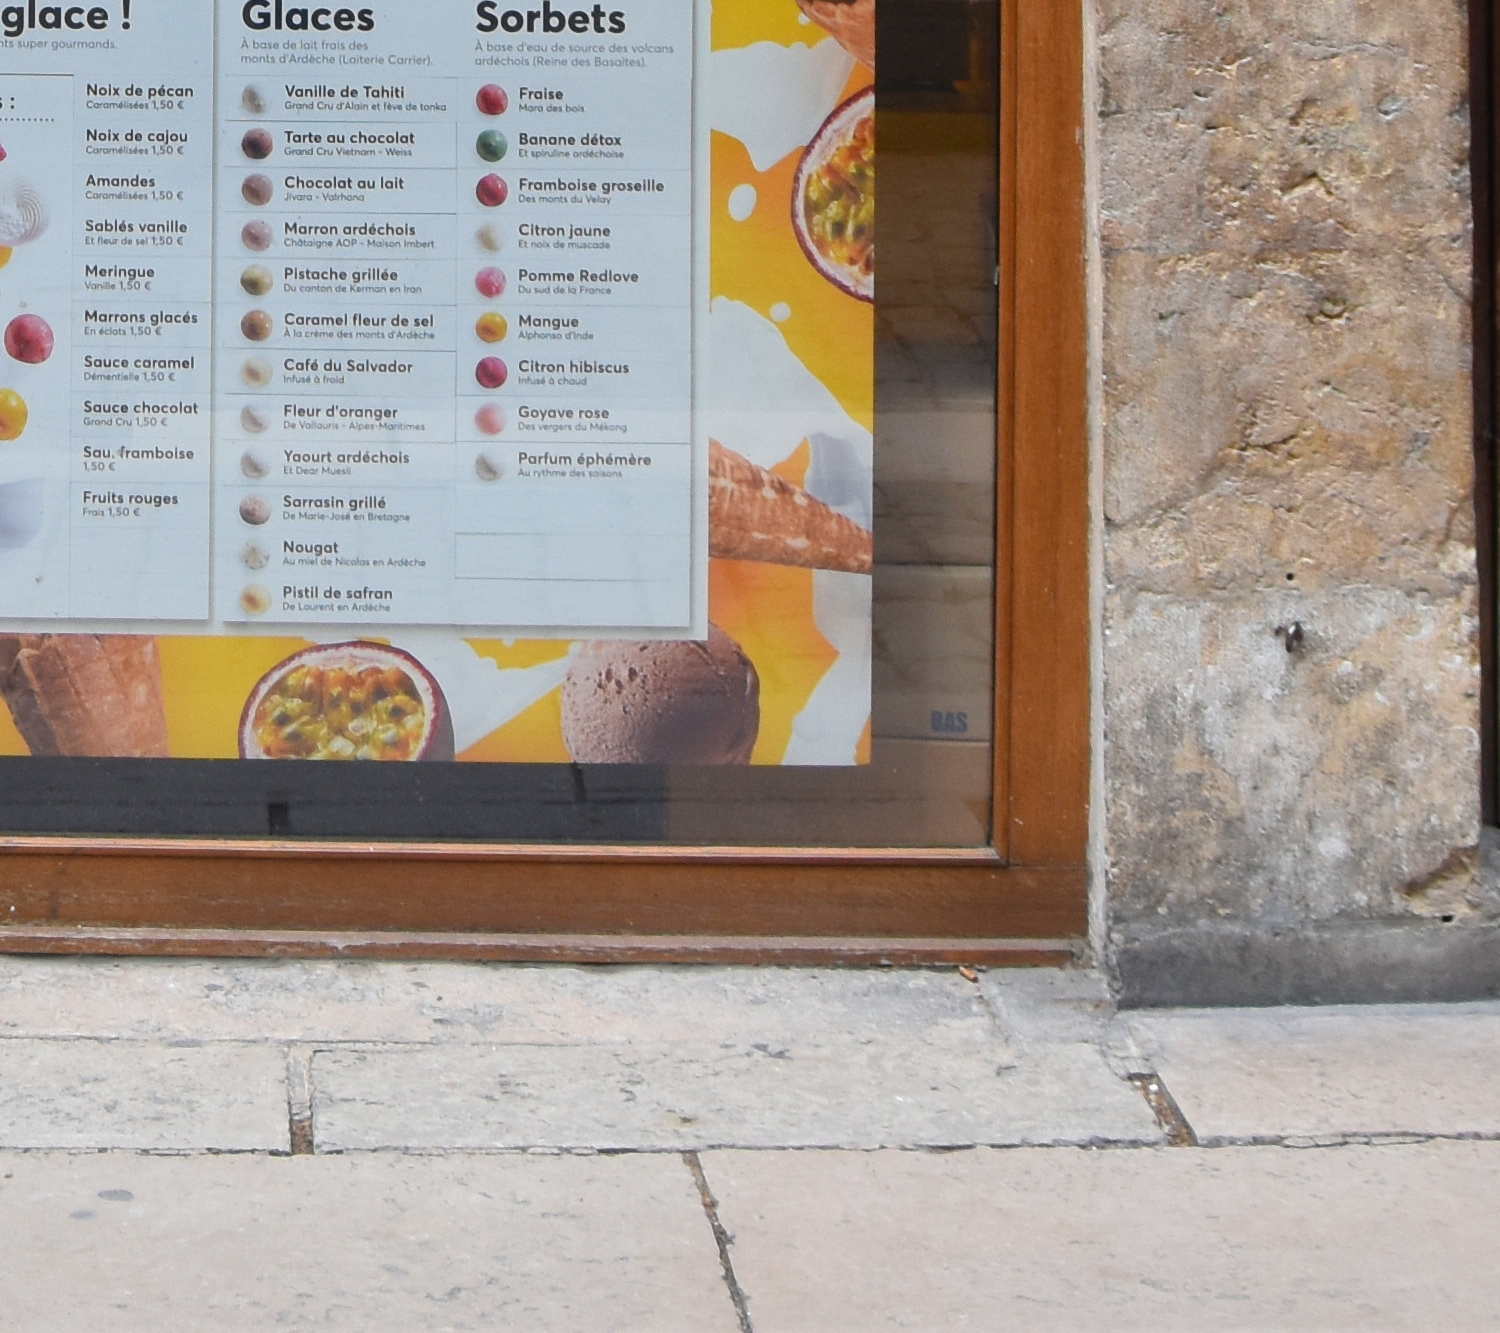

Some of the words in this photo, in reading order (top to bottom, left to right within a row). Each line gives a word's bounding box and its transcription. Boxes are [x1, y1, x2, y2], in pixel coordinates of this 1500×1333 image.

[476, 0, 625, 33] Sorbets
[86, 83, 121, 97] Noix
[124, 82, 144, 97] de
[147, 84, 194, 100] pécan
[284, 84, 336, 98] Vanille
[339, 84, 359, 99] de
[362, 84, 405, 99] Tahiti
[519, 86, 564, 101] Fraise
[10, 96, 15, 110] :
[283, 130, 323, 144] Tarte
[326, 134, 346, 144] au
[349, 130, 416, 145] chocolat
[518, 132, 576, 146] Banane
[580, 132, 622, 147] détox
[85, 173, 156, 188] Amandes
[519, 177, 598, 192] Framboise
[601, 178, 665, 195] groseille
[85, 218, 135, 233] Sablés
[138, 219, 188, 234] vanille
[284, 221, 339, 236] Marron
[342, 221, 416, 236] ardéchois
[518, 223, 566, 237] Citron
[568, 223, 611, 240] jaune
[284, 266, 348, 281] Pistache
[351, 267, 399, 284] grillée
[518, 268, 575, 283] Pomme
[579, 269, 639, 283] Redlove
[84, 309, 146, 324] Marrons
[149, 309, 198, 327] glacés
[518, 313, 580, 331] Mangue
[84, 354, 130, 369] Sauce
[133, 355, 195, 370] caramel
[283, 358, 319, 372] Café
[323, 358, 342, 372] du
[346, 358, 414, 374] Salvador
[518, 359, 565, 374] Citron
[569, 359, 630, 374] hibiscus
[283, 403, 322, 418] Fleur
[325, 404, 399, 422] d'oranger
[518, 405, 574, 422] Goyave
[578, 409, 610, 419] rose
[518, 451, 573, 466] Parfum
[576, 452, 652, 469] éphémère
[83, 490, 124, 505] Fruits
[128, 494, 179, 508] rouges
[283, 494, 345, 509] Sarrasin
[348, 495, 387, 512] grillé
[283, 540, 339, 557] Nougat
[282, 585, 319, 599] Pistil
[323, 585, 342, 599] de
[346, 585, 393, 600] safran
